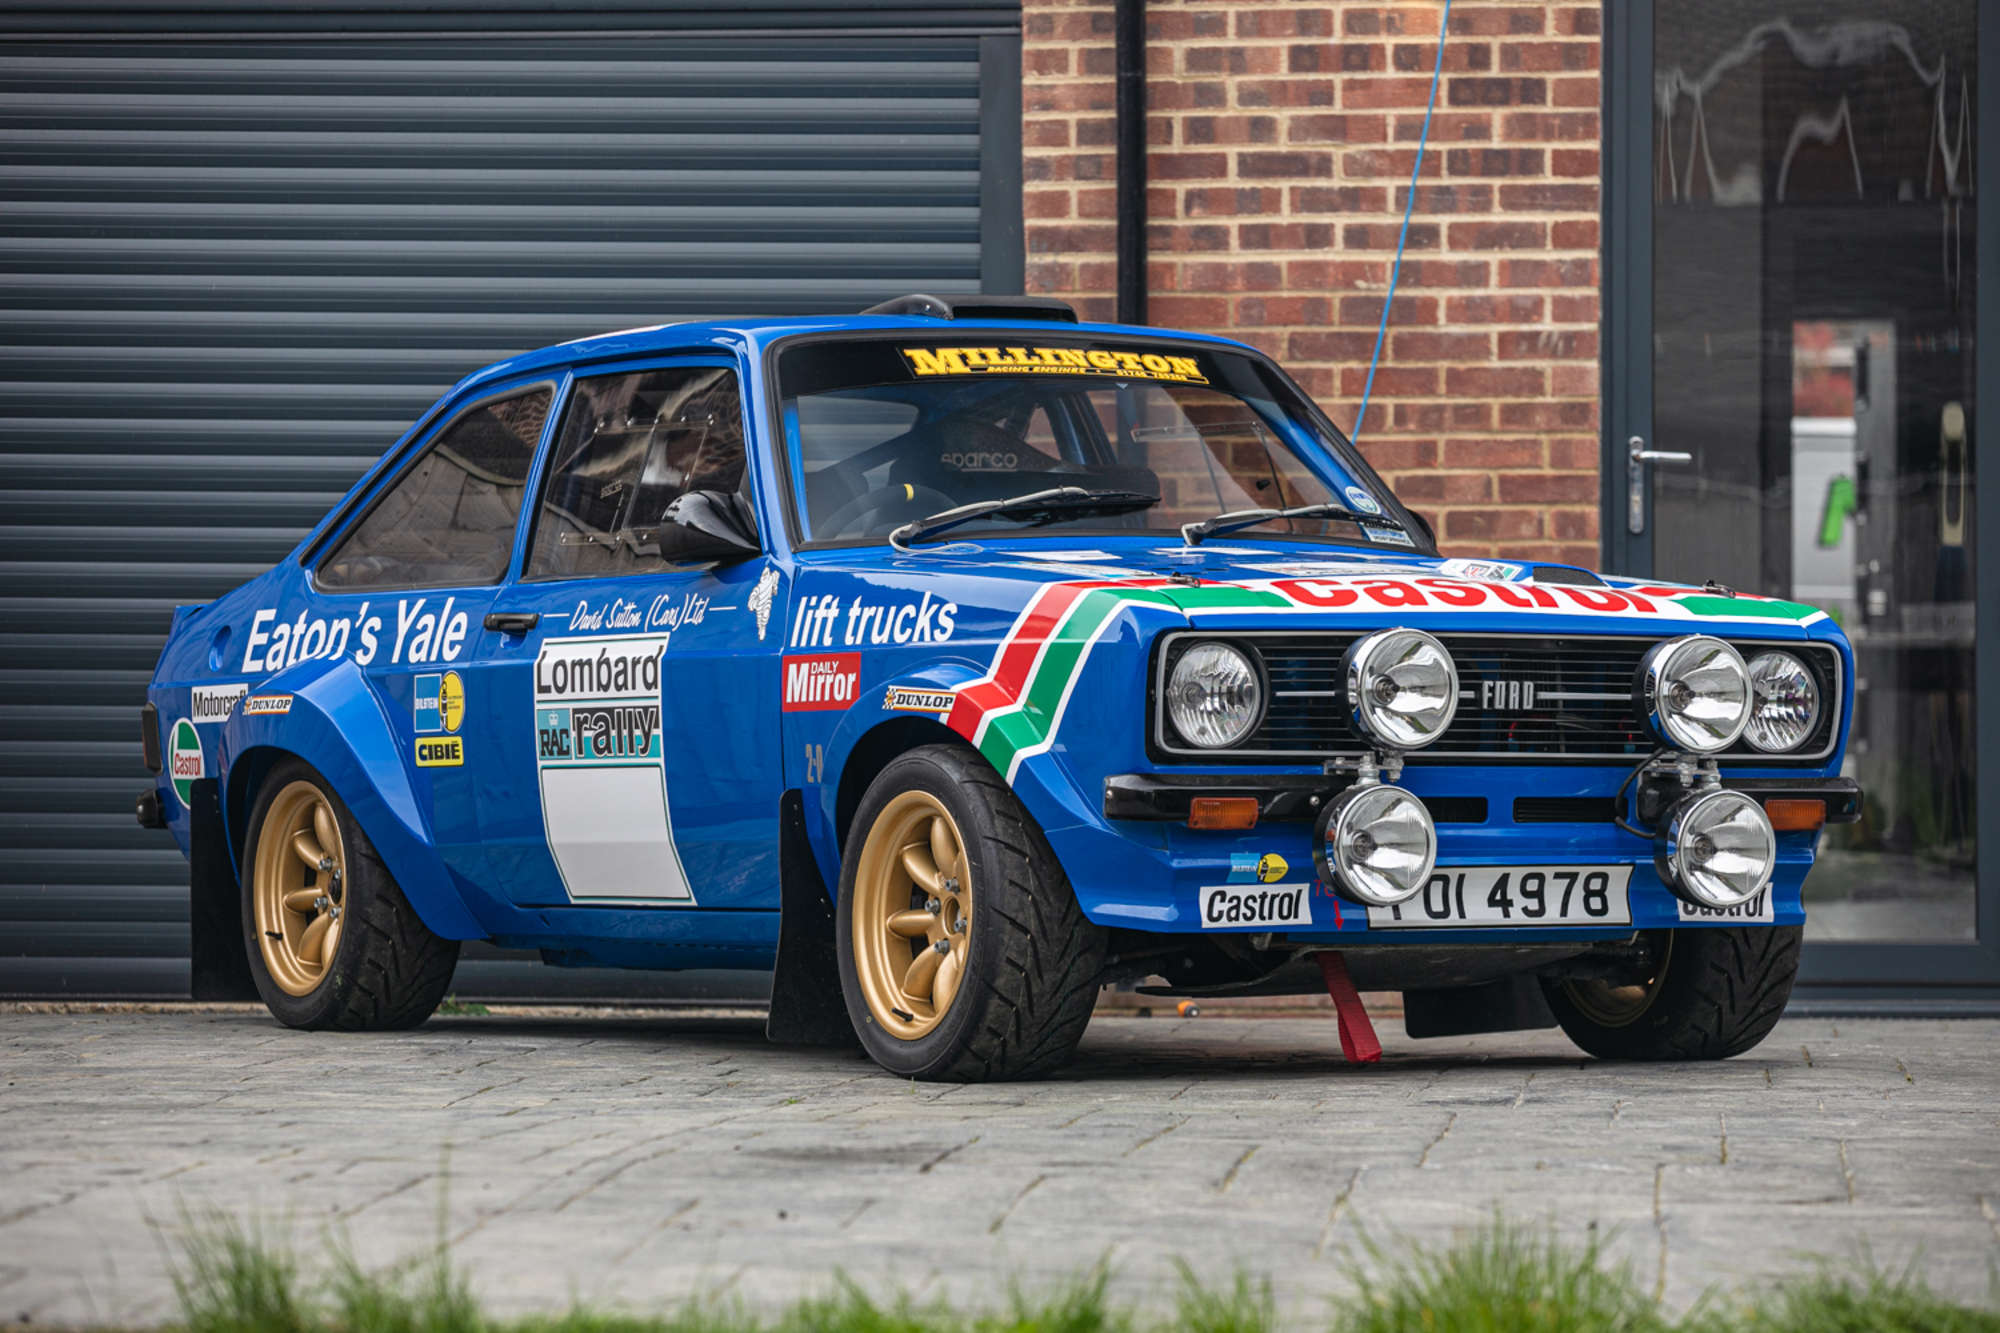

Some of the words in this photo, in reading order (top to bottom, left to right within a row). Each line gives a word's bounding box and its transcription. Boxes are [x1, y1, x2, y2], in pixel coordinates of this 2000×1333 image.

[904, 347, 1202, 377] MILLINGTON
[986, 366, 1029, 374] RACING
[1032, 366, 1086, 375] ENGINES
[569, 600, 608, 631] David
[606, 598, 642, 629] Sutton
[790, 594, 840, 648] lift
[844, 591, 958, 646] trucks
[241, 601, 382, 673] Eaton's
[391, 597, 468, 664] Yale
[536, 645, 664, 694] Lombard
[786, 661, 857, 703] Mirror
[811, 661, 839, 674] DAILY
[193, 689, 246, 717] Motorcr
[251, 699, 291, 711] DUNLOP
[896, 694, 954, 708] DUNLOP
[1482, 680, 1534, 710] FORD
[540, 728, 570, 757] RAC
[574, 708, 657, 758] rally
[174, 752, 201, 776] Castrol
[1207, 889, 1303, 923] Castrol
[1392, 873, 1467, 920] OI
[1487, 871, 1609, 919] 4978
